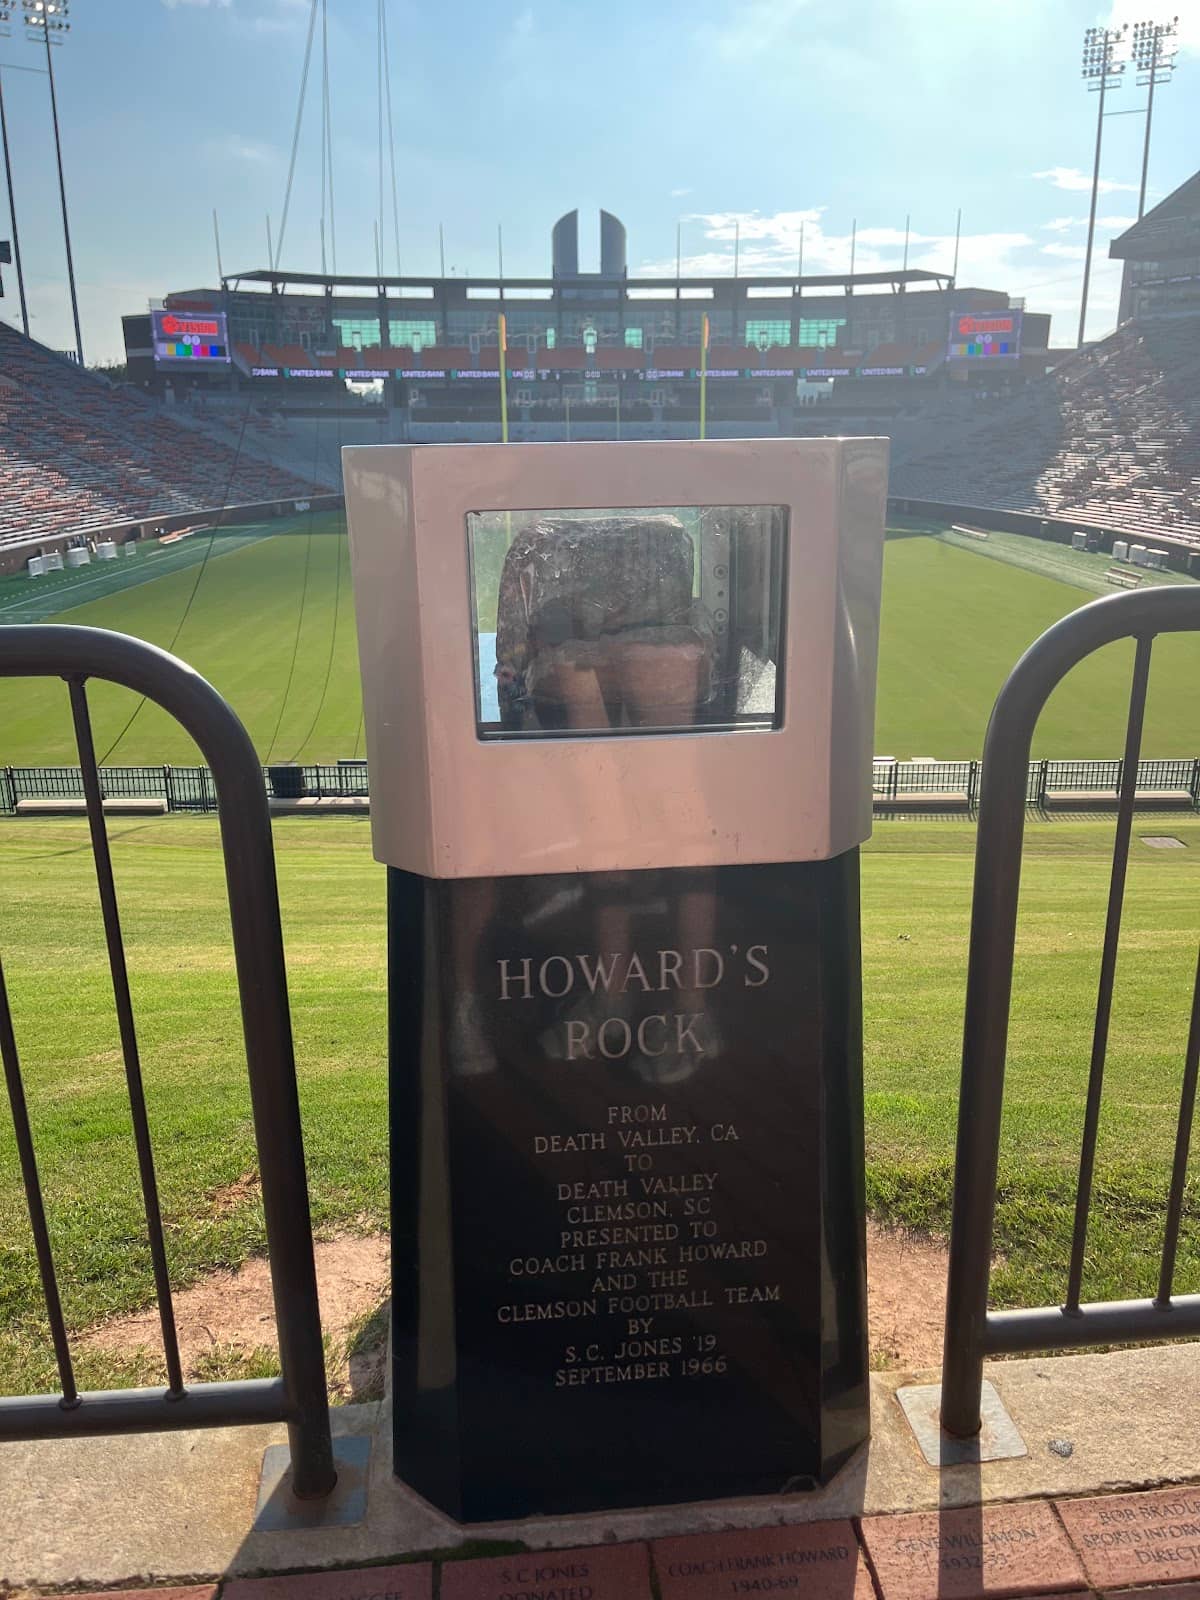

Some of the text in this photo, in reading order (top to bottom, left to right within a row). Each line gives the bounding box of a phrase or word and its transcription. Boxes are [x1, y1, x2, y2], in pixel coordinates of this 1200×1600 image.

[497, 945, 770, 1000] HOWARD'S
[564, 1013, 705, 1060] ROCK
[607, 1104, 667, 1124] FROM
[534, 1133, 606, 1154] DEATH
[711, 1124, 739, 1142] CA
[624, 1154, 653, 1172] TO
[558, 1173, 718, 1201] DEATH VALLEY
[684, 1197, 711, 1215] SC
[560, 1221, 717, 1249] PRESENTED TO
[509, 1240, 768, 1276] COACH FRANK HOWARD
[591, 1269, 689, 1293] AND THE
[497, 1285, 781, 1323] CLEMSON FOOTBALL TEAM
[627, 1318, 654, 1336] BY
[614, 1337, 682, 1359] JONES
[691, 1335, 717, 1352] '19
[555, 1355, 727, 1387] SEPTEMBER 1966
[1098, 1508, 1136, 1525] BOB
[1083, 1529, 1142, 1547] SPORTS
[779, 1546, 849, 1565] HOWARD
[1135, 1545, 1200, 1564] DIRECT
